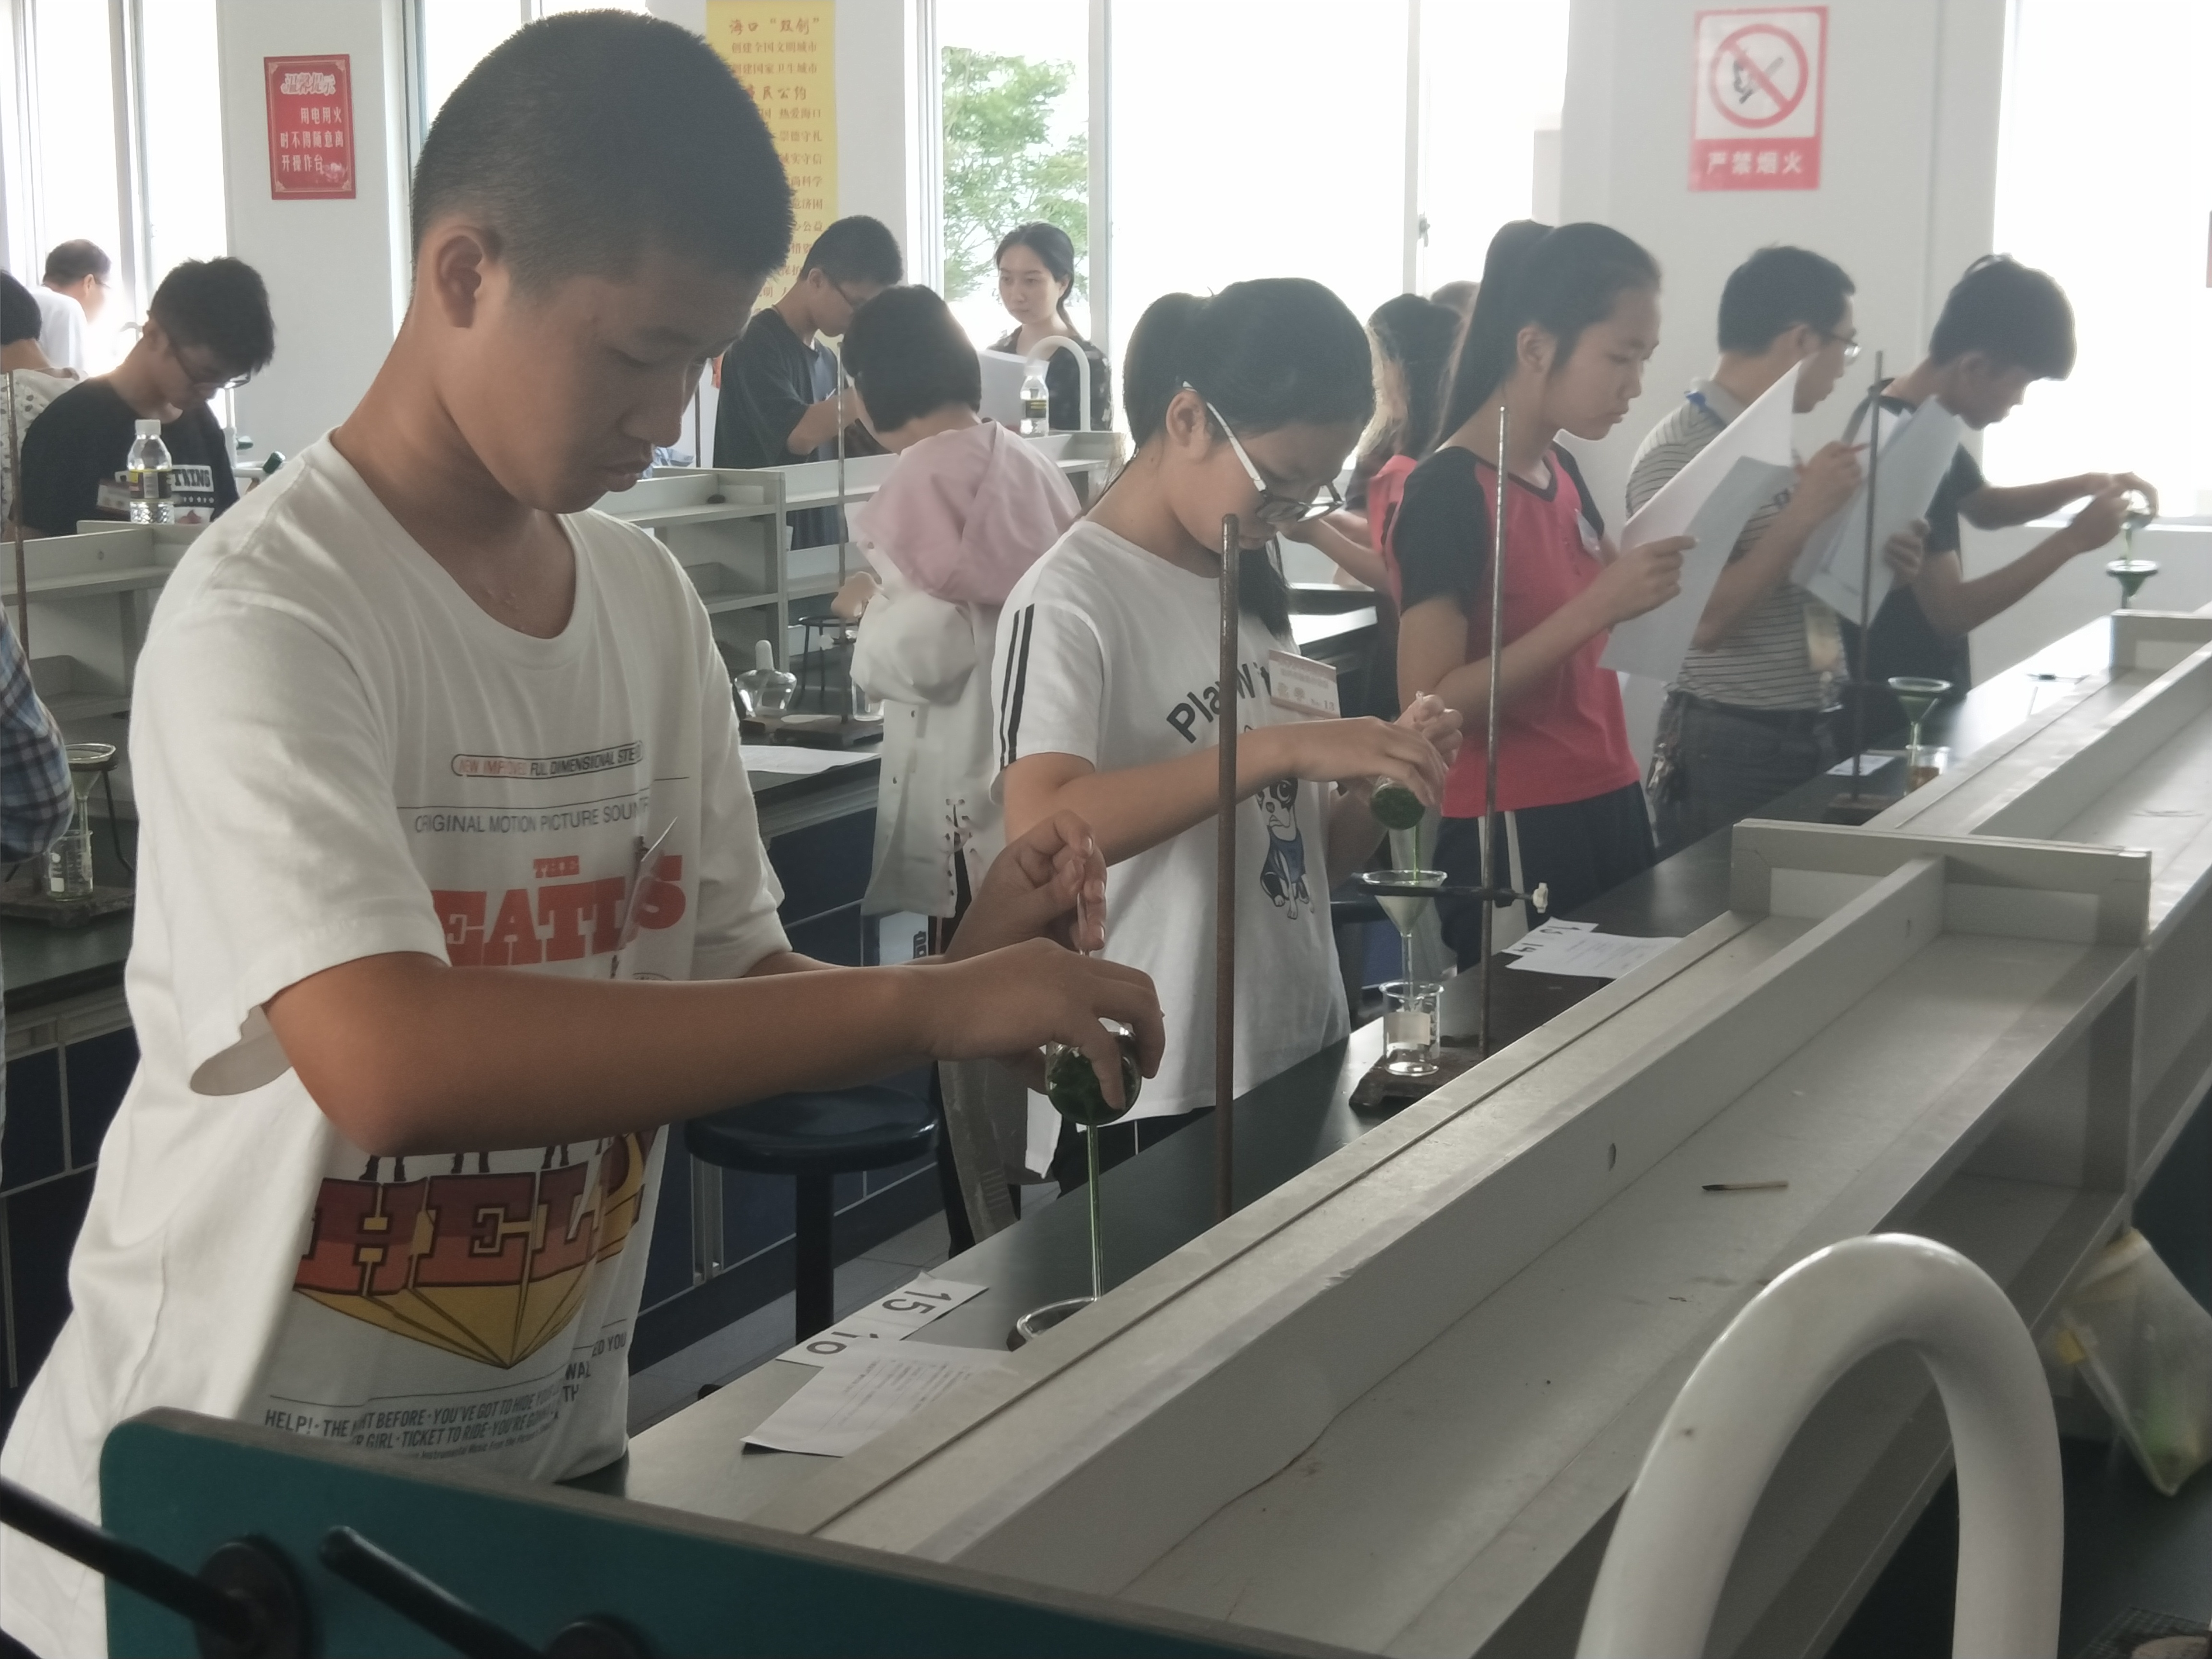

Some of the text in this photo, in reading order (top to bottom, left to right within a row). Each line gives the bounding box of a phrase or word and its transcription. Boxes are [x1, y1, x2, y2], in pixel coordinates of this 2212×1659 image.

[301, 107, 342, 124] 用电用火
[280, 130, 344, 149] 时不得随意离
[282, 155, 324, 173] 开操作台
[415, 814, 485, 833] ORIGINAL
[489, 816, 536, 833] MOTION
[541, 808, 599, 831] PICTURE
[882, 1290, 951, 1314] 15
[323, 1419, 350, 1437] THE
[376, 1409, 427, 1429] BEFORE
[477, 1401, 500, 1420] GOT
[501, 1398, 513, 1415] TO
[366, 1432, 393, 1449] GIRL
[402, 1428, 445, 1448] TICKET
[446, 1426, 461, 1443] TO
